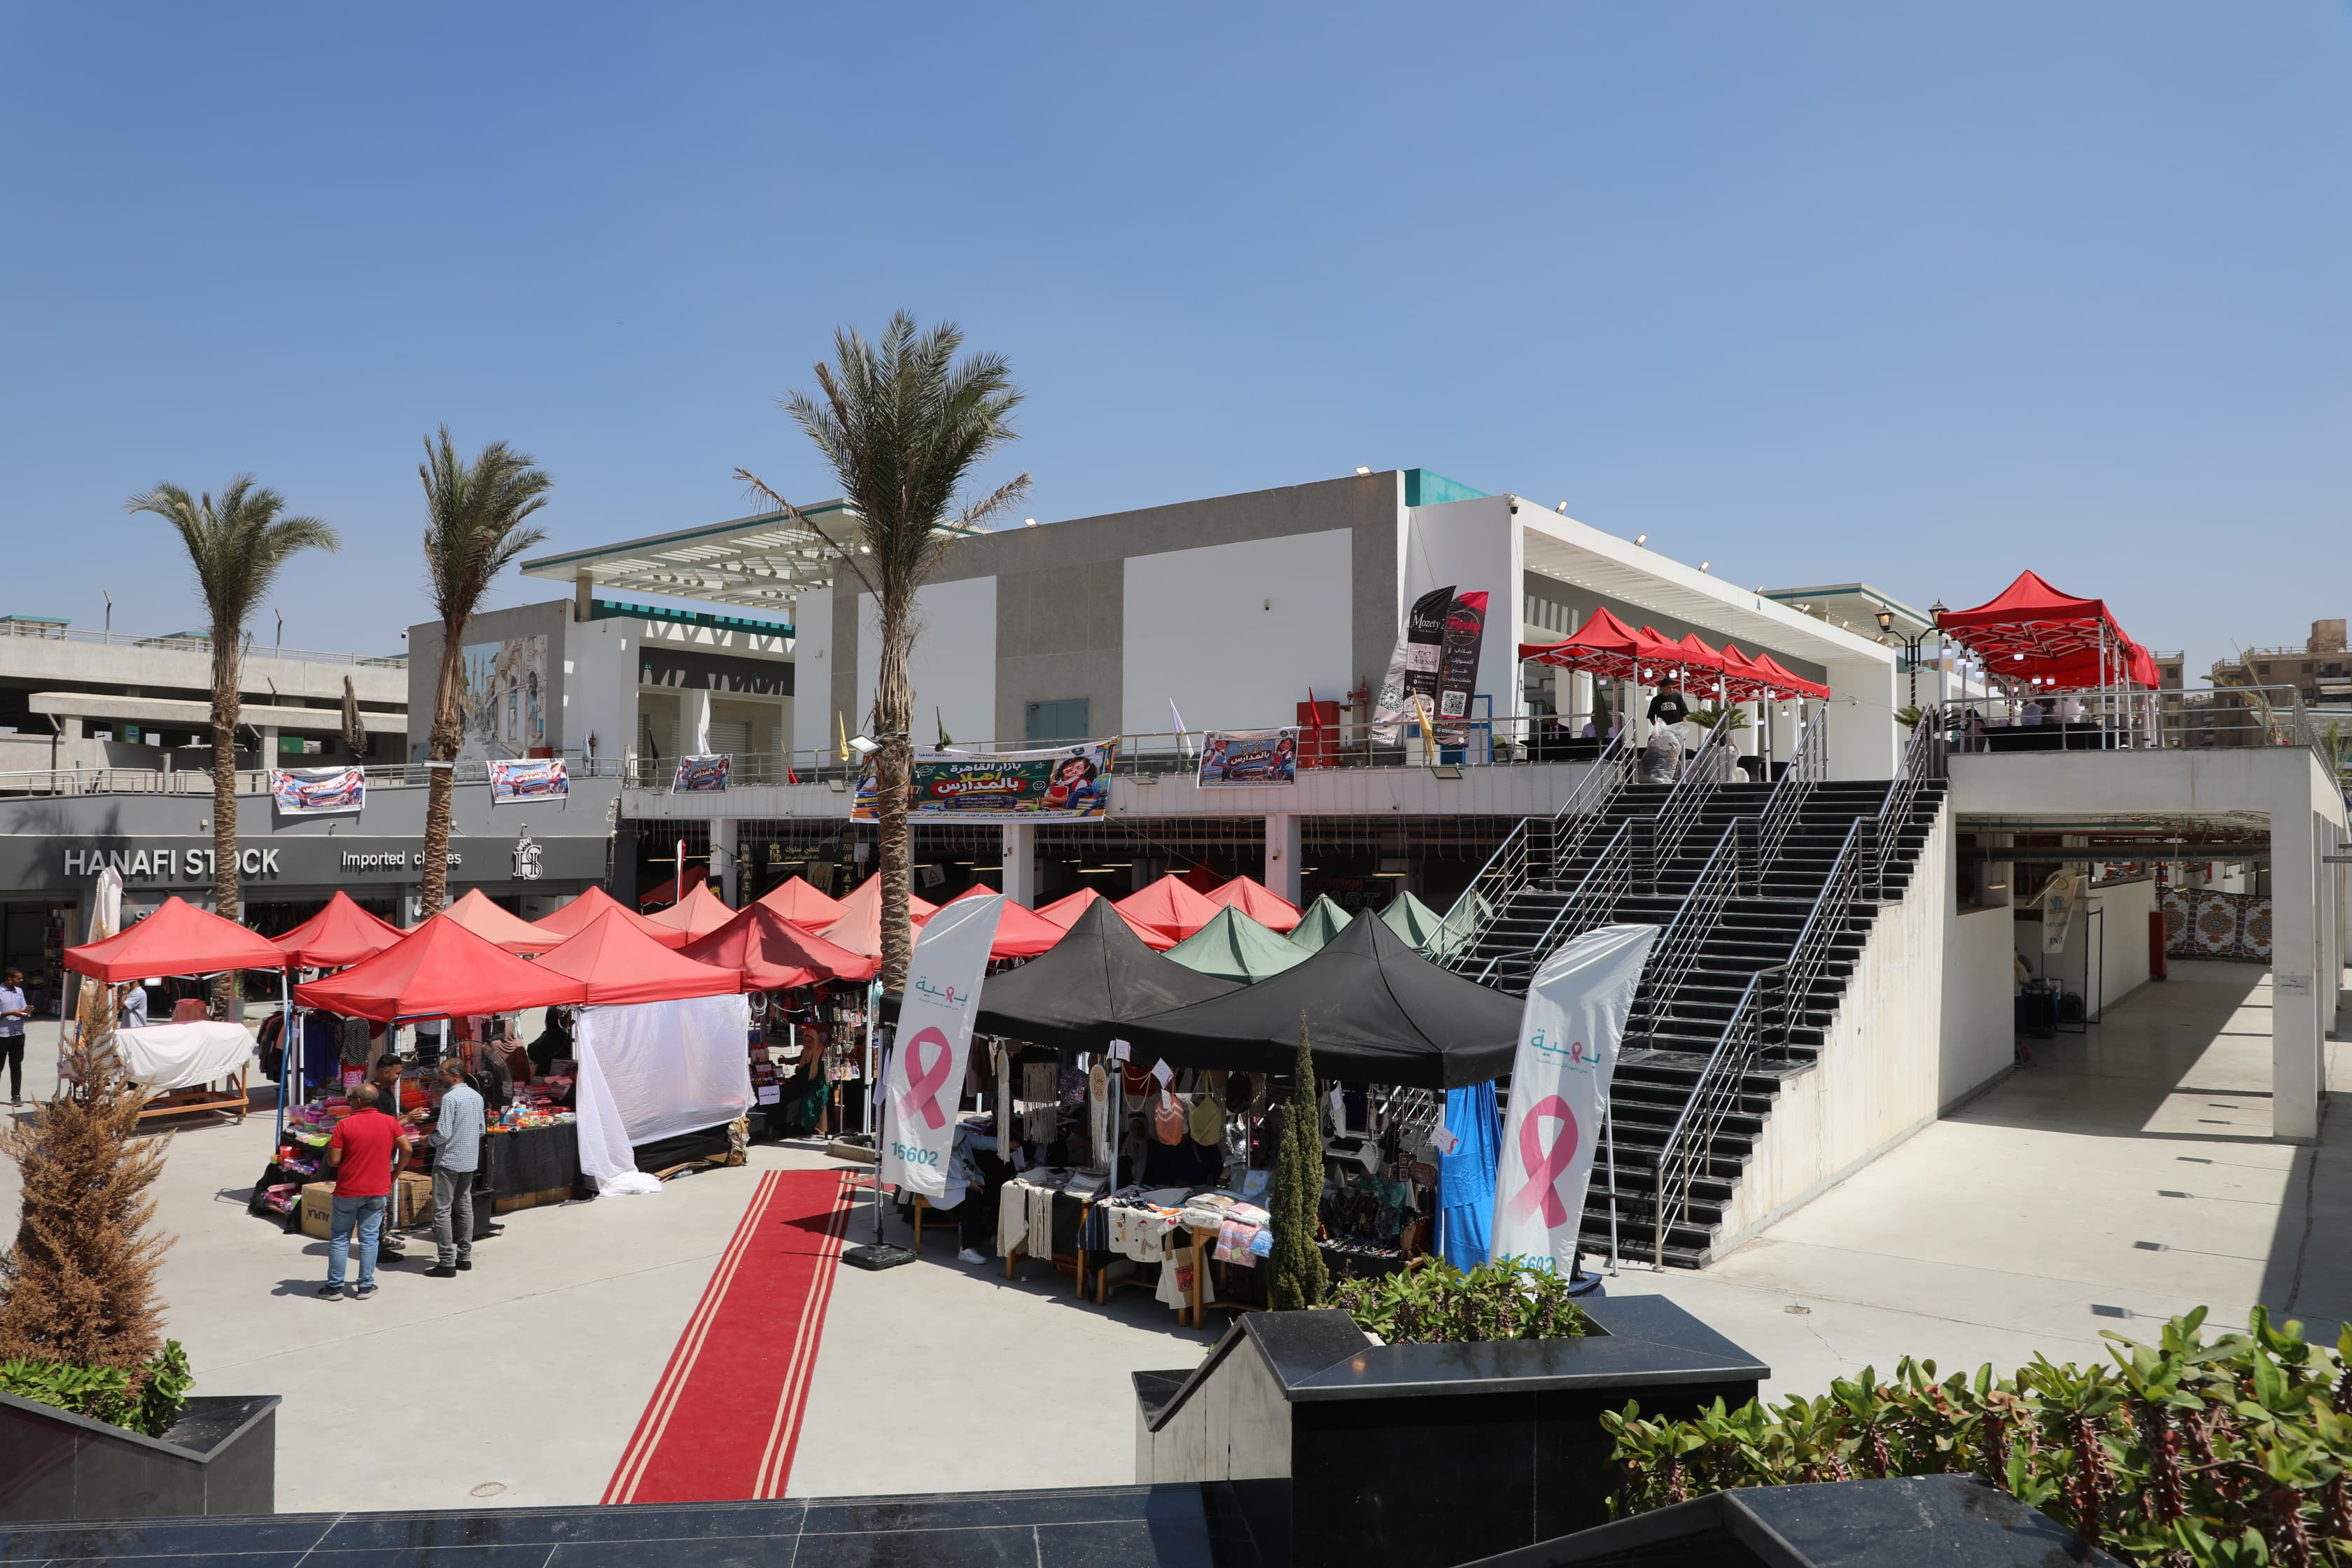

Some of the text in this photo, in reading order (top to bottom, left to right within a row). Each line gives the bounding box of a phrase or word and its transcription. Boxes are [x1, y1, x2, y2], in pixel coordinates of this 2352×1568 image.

[1231, 750, 1270, 764] بالمدارس
[950, 762, 1021, 774] بازار القاهرة
[938, 777, 1019, 794] بالمدارس
[64, 849, 281, 875] HANAFI STCK
[342, 851, 462, 869] Imported cles
[891, 1141, 938, 1167] 16602
